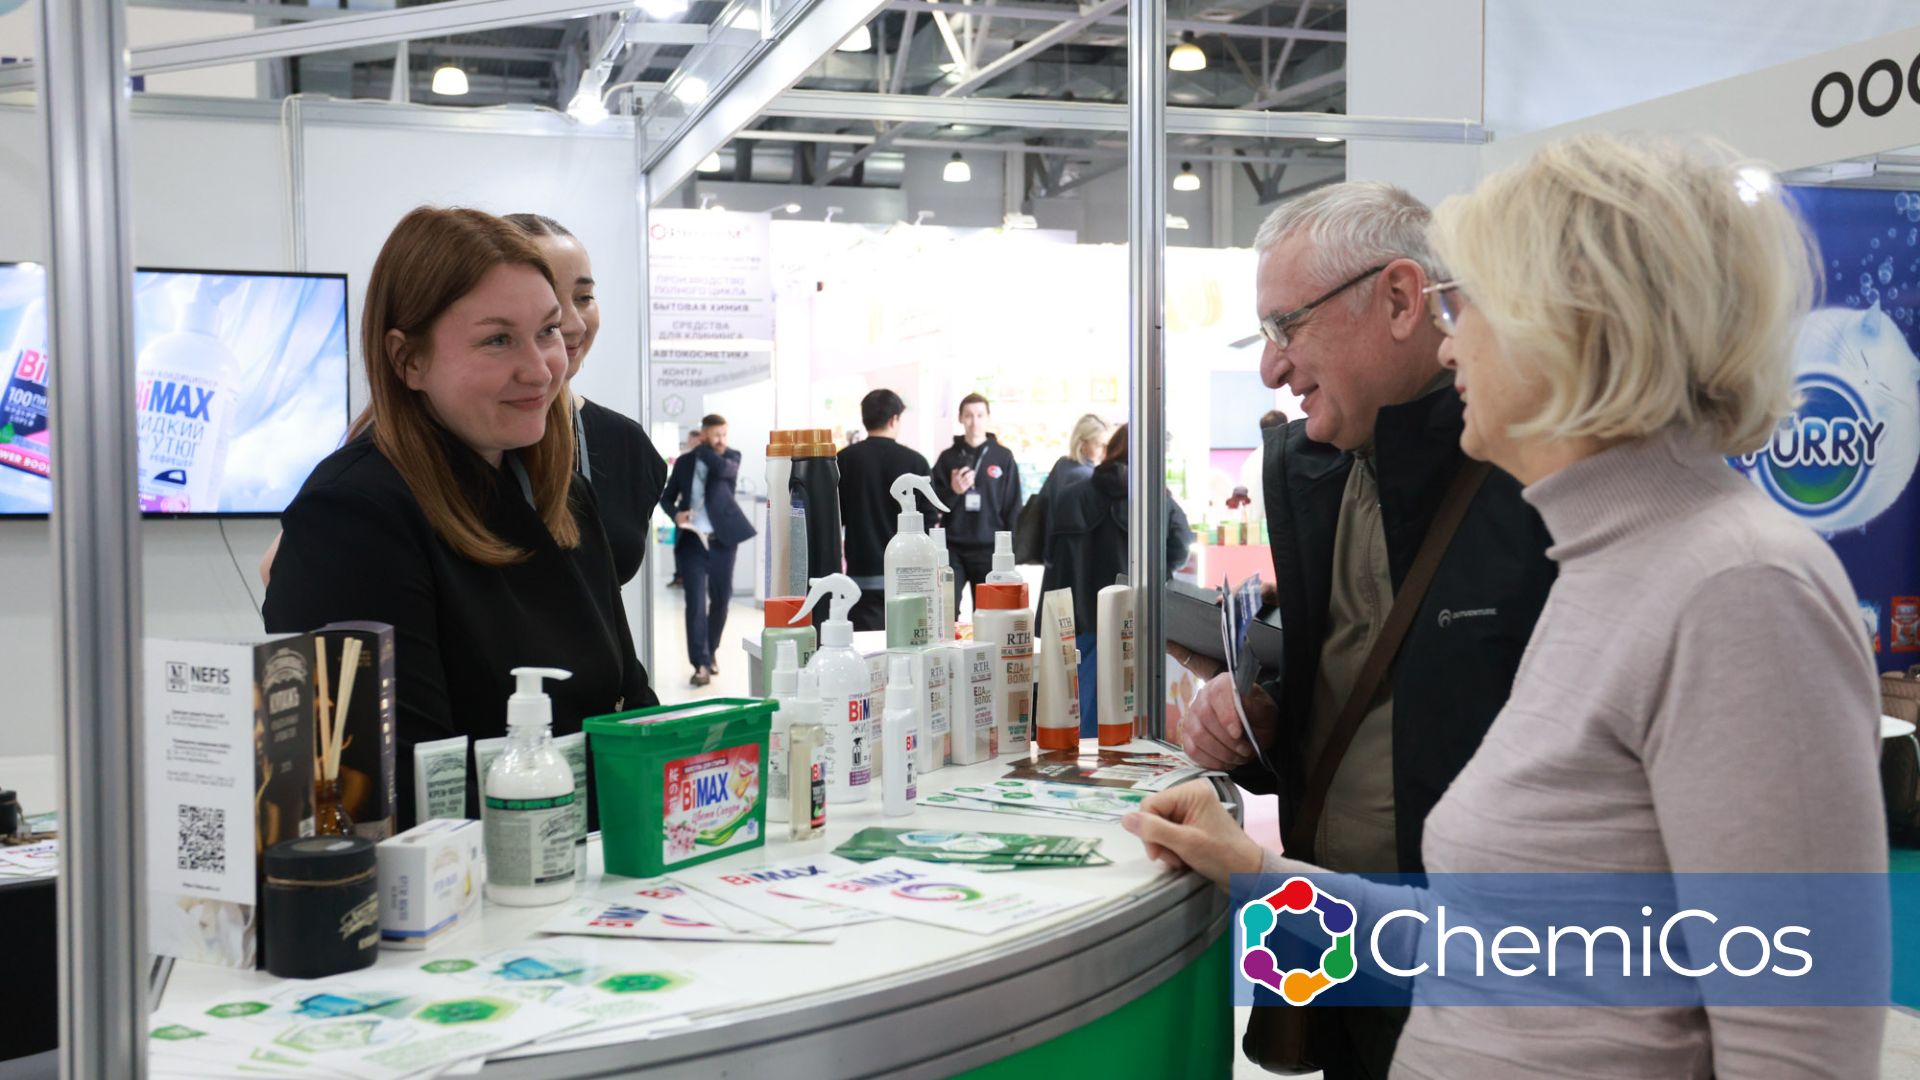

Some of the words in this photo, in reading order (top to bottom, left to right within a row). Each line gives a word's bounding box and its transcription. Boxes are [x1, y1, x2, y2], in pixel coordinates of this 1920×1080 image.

[1811, 53, 1920, 128] ОО
[653, 303, 707, 312] БЫТОВАЯ
[710, 303, 749, 312] ХИМИЯ
[672, 321, 730, 331] СРЕДСТВА
[658, 331, 683, 341] ДЛЯ
[685, 331, 744, 340] КЛИНИНГА
[653, 350, 749, 359] АВТОКОСМЕТИКА
[16, 349, 48, 384] Bi
[153, 435, 201, 458] УТЮГ
[1742, 418, 1885, 467] URRY
[1006, 632, 1032, 646] RTH
[190, 665, 230, 685] NEFIS
[973, 661, 990, 672] RTH
[1006, 662, 1024, 673] ЕДА
[682, 772, 729, 811] BiMAX
[719, 865, 828, 886] BiMAX
